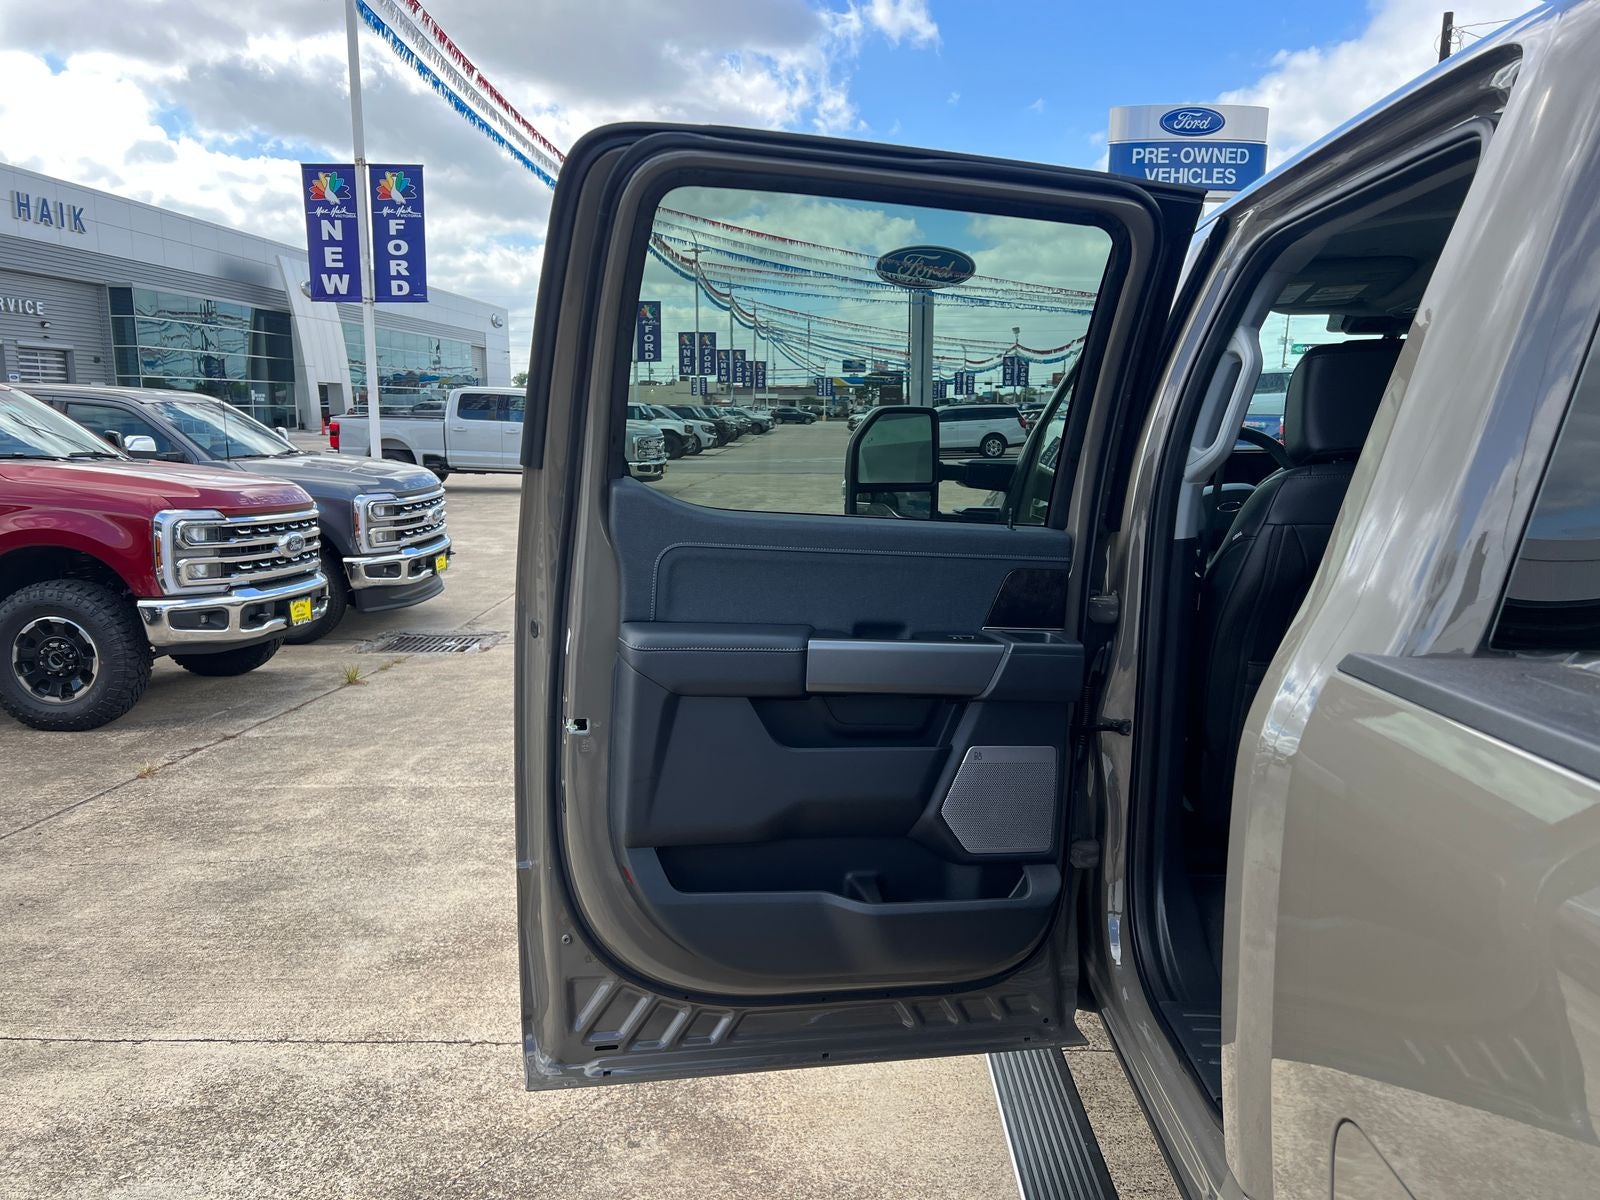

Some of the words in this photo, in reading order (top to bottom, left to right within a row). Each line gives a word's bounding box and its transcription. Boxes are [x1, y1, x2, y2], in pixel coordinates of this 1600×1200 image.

[1173, 111, 1211, 130] Ford
[1145, 167, 1237, 185] VEHICLES
[11, 190, 87, 233] HAIK
[320, 219, 350, 295] NEW
[387, 219, 410, 296] FORD
[897, 253, 956, 278] Ford
[643, 325, 655, 360] FORD
[682, 349, 692, 374] NEW
[703, 349, 711, 374] FORD
[720, 362, 728, 382] NEW
[1004, 368, 1012, 385] NEW
[289, 538, 303, 551] Ford
